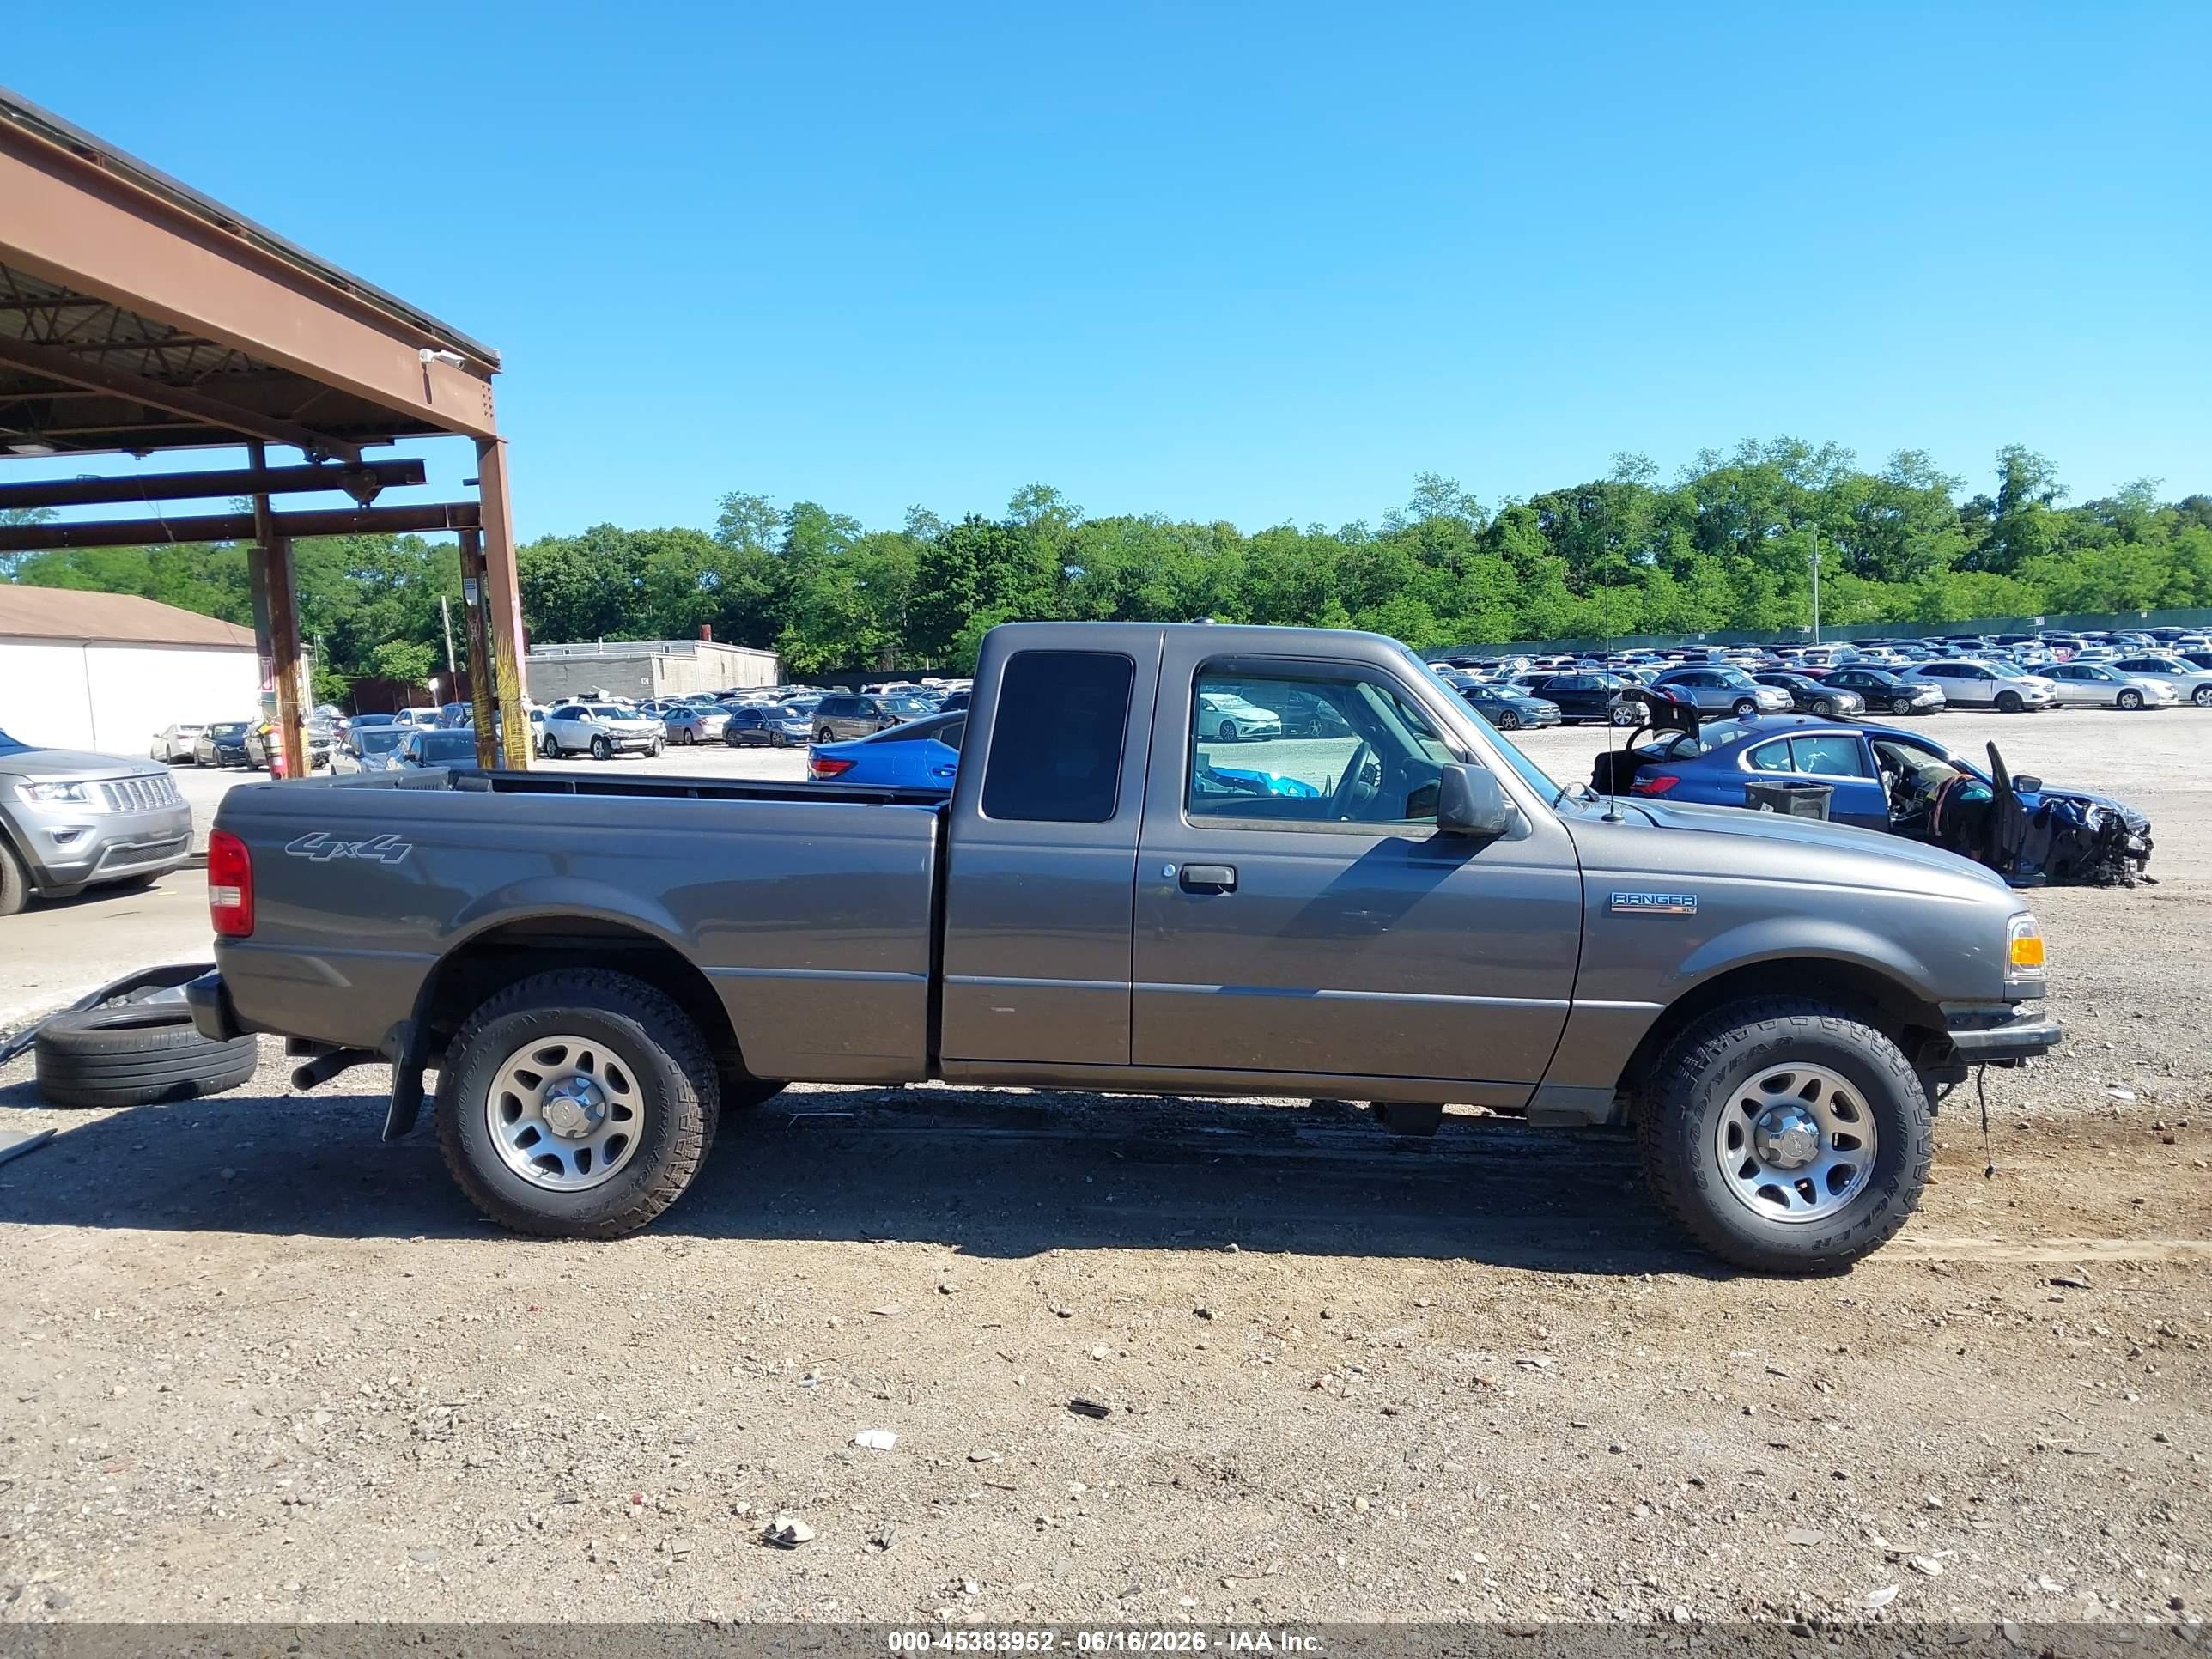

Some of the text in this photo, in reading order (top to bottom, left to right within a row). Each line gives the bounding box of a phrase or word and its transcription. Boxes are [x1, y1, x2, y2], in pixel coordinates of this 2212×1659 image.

[285, 832, 412, 864] 4x4
[1612, 893, 1696, 907] RANGER
[459, 1010, 562, 1155] GOODYAR
[1689, 1036, 1794, 1190] GOODYEAR
[1812, 1101, 1909, 1251] WRANGLER
